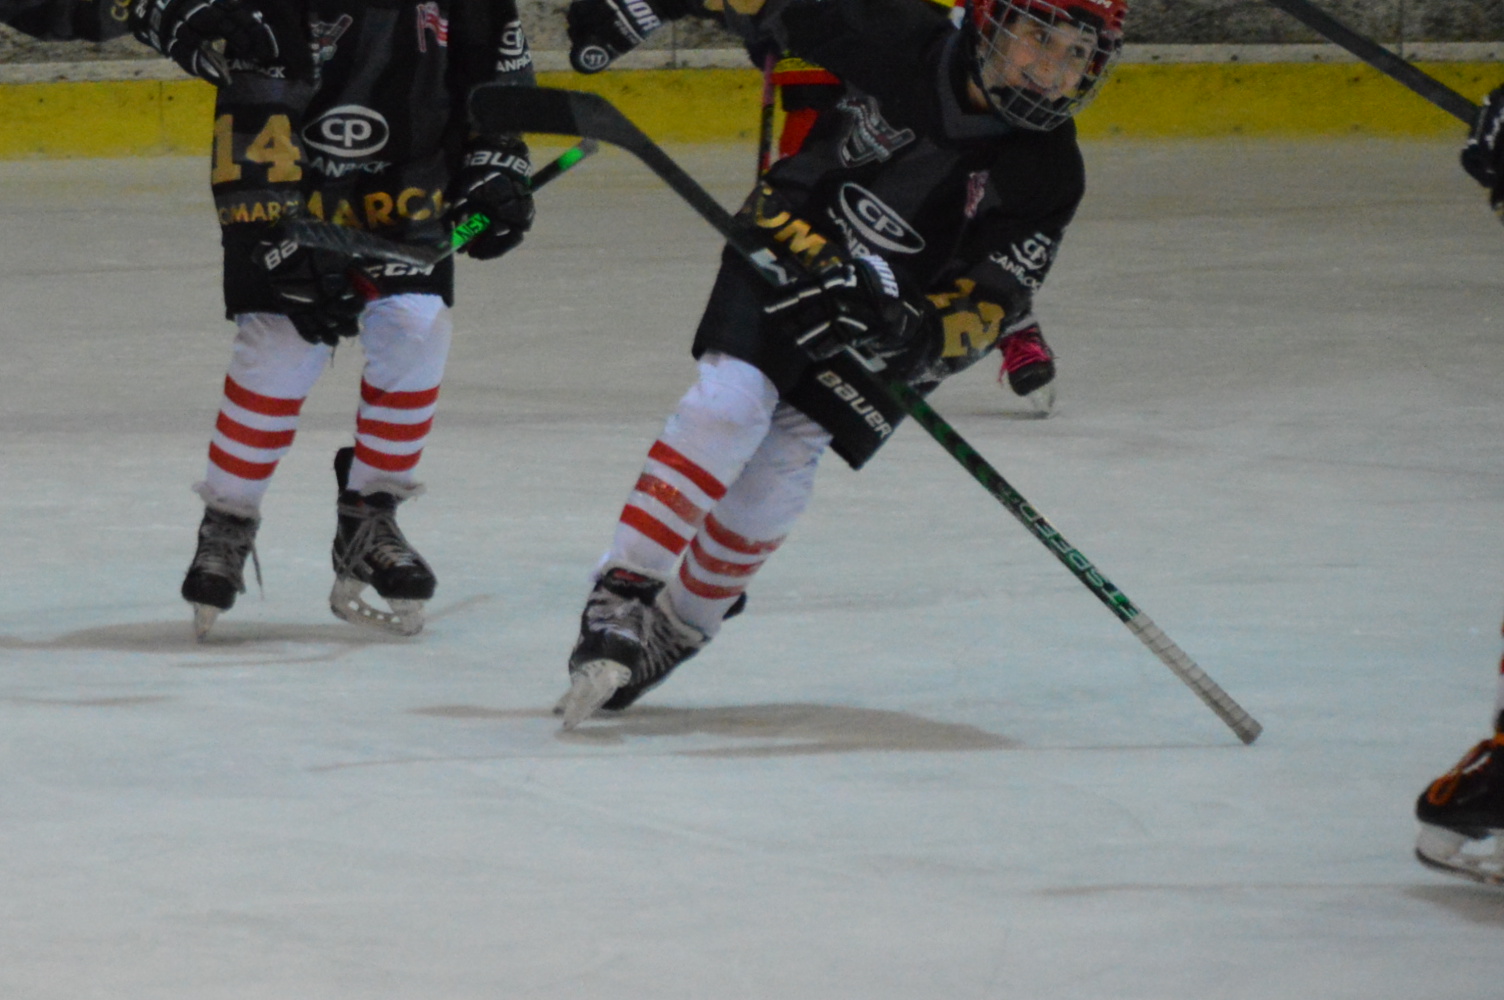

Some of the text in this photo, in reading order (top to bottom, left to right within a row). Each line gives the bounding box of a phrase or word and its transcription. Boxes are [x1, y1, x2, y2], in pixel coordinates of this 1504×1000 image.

[212, 113, 303, 185] 14
[816, 370, 893, 440] BAUER
[1019, 501, 1139, 620] ETSPEED
